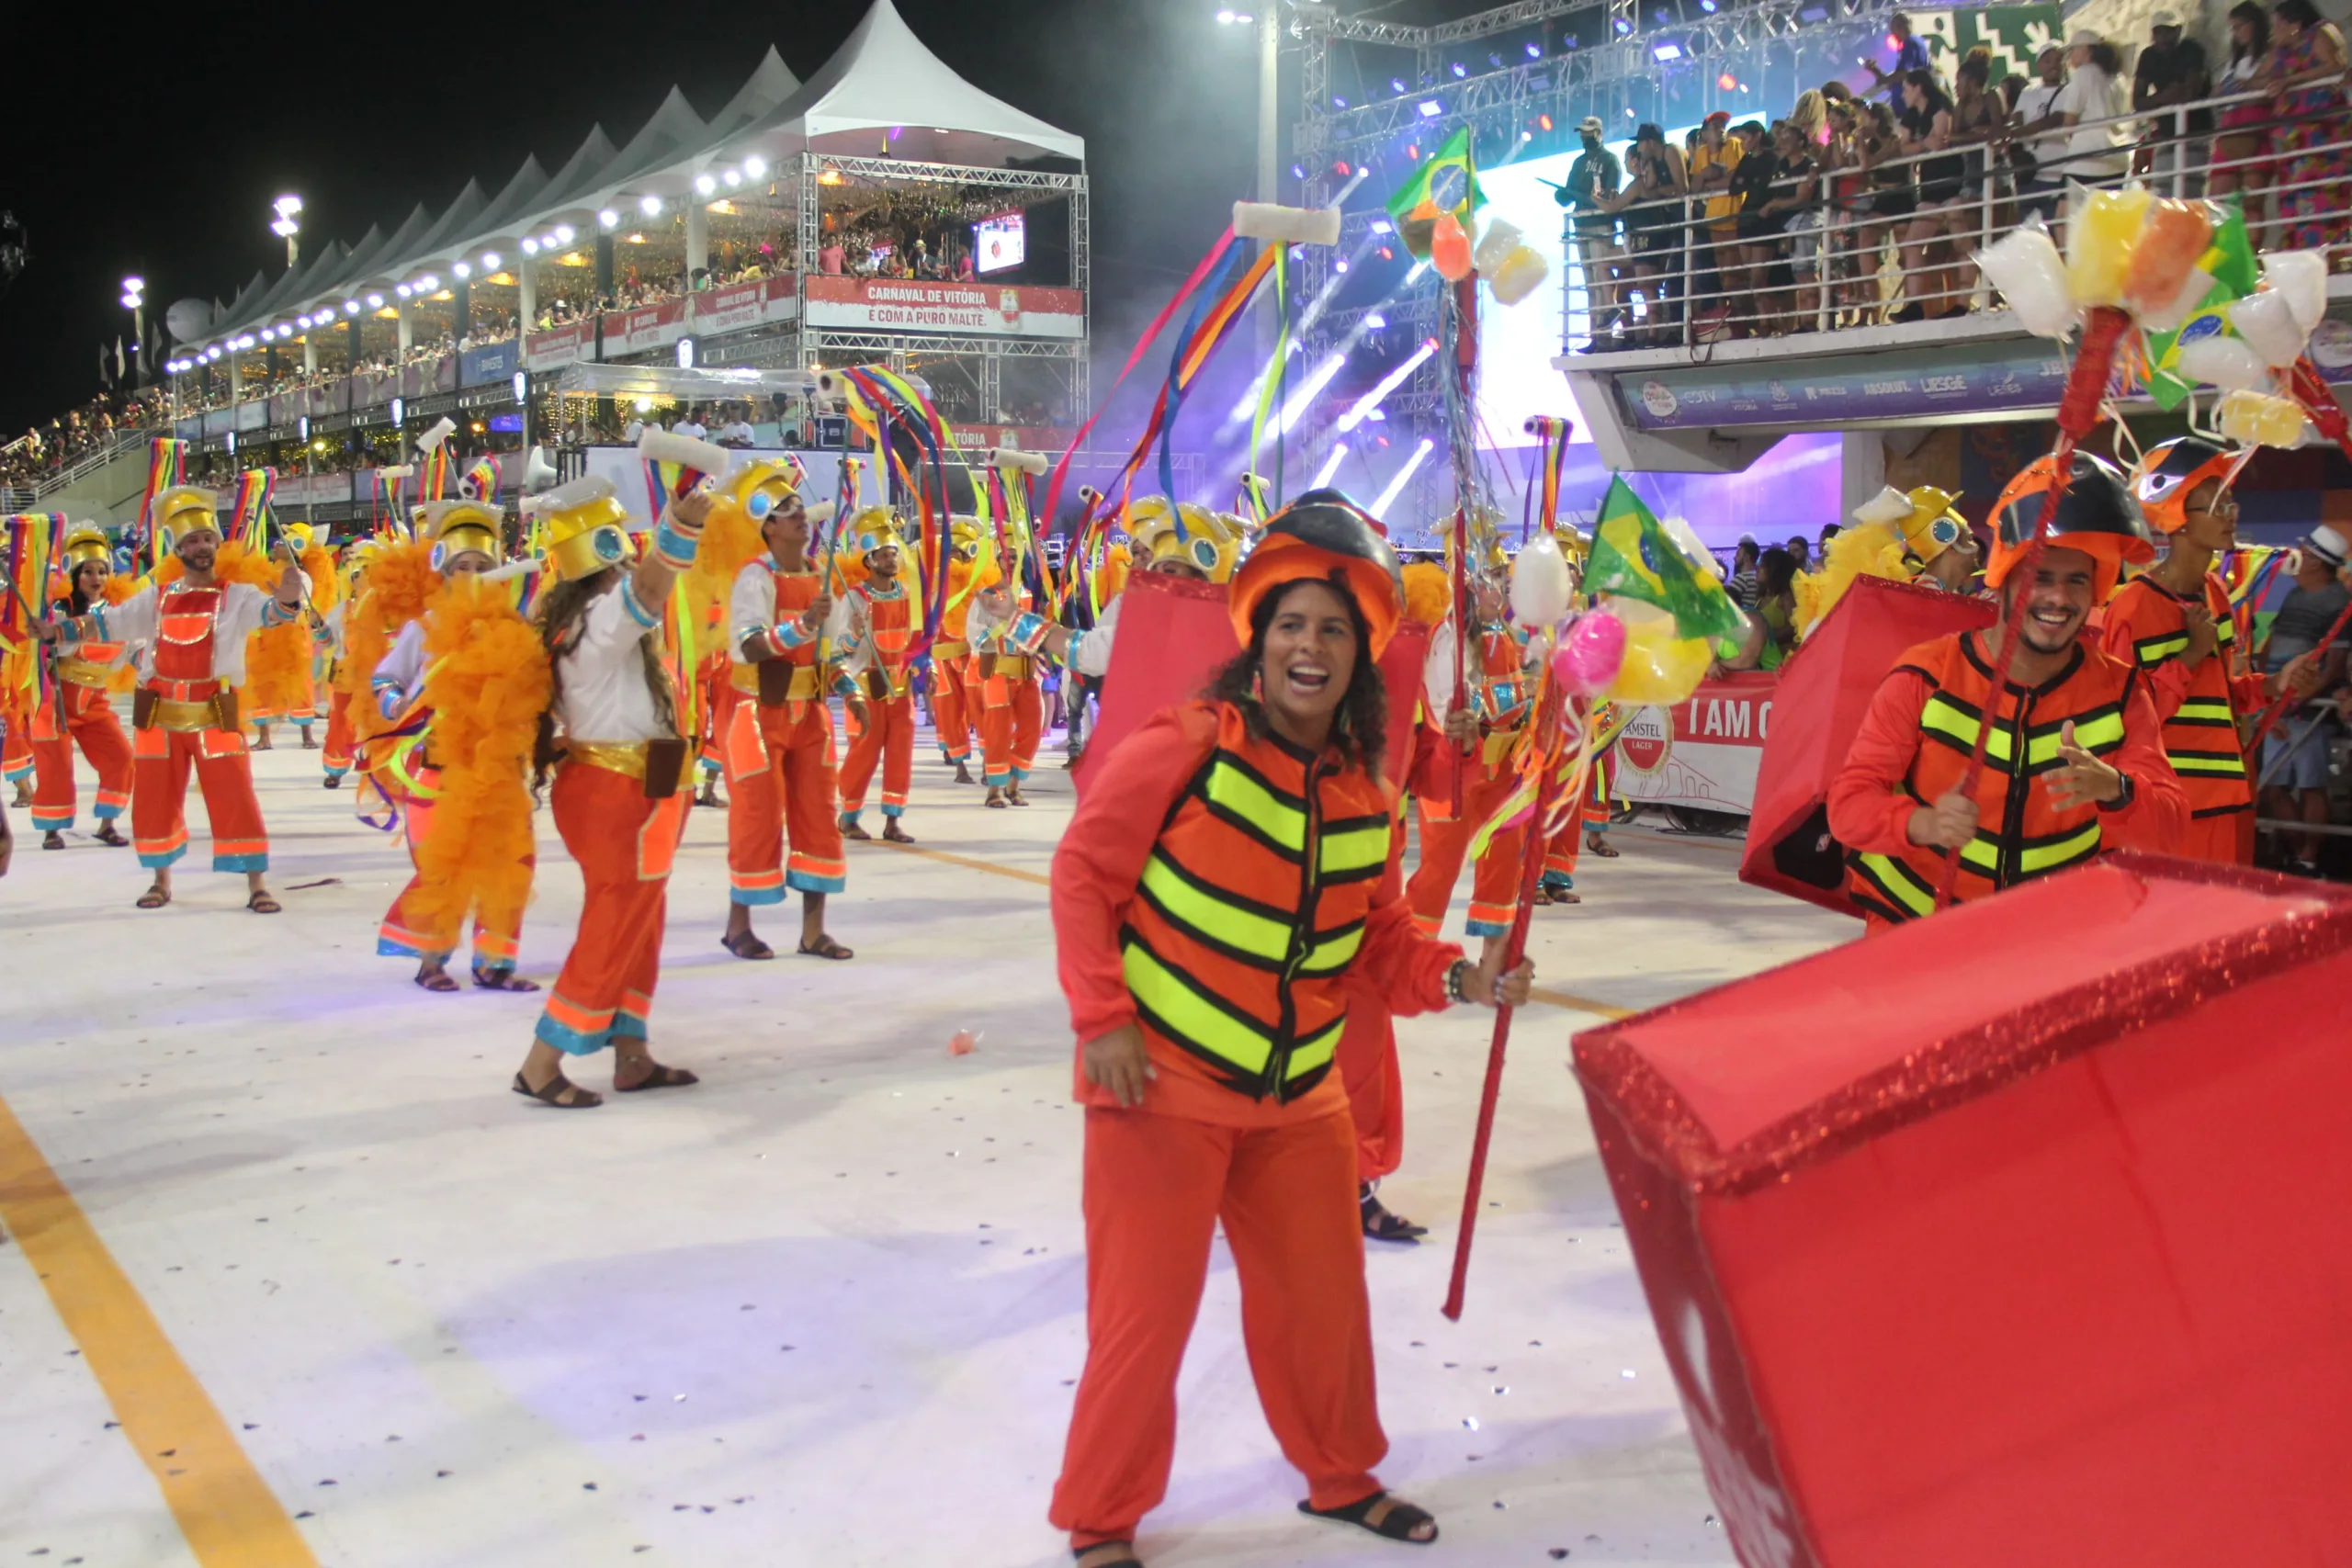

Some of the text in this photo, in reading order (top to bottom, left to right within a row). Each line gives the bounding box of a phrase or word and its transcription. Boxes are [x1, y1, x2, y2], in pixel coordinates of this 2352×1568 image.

[868, 287, 987, 305] CARNAVAL DE VITÓRIA
[877, 310, 904, 323] COM
[906, 310, 914, 323] A
[916, 311, 946, 325] PURO
[948, 313, 988, 327] MALTE.
[1689, 698, 1699, 735] I
[1703, 699, 1750, 739] AM
[1625, 723, 1661, 738] AMSTEL
[1632, 740, 1653, 750] LAGER
